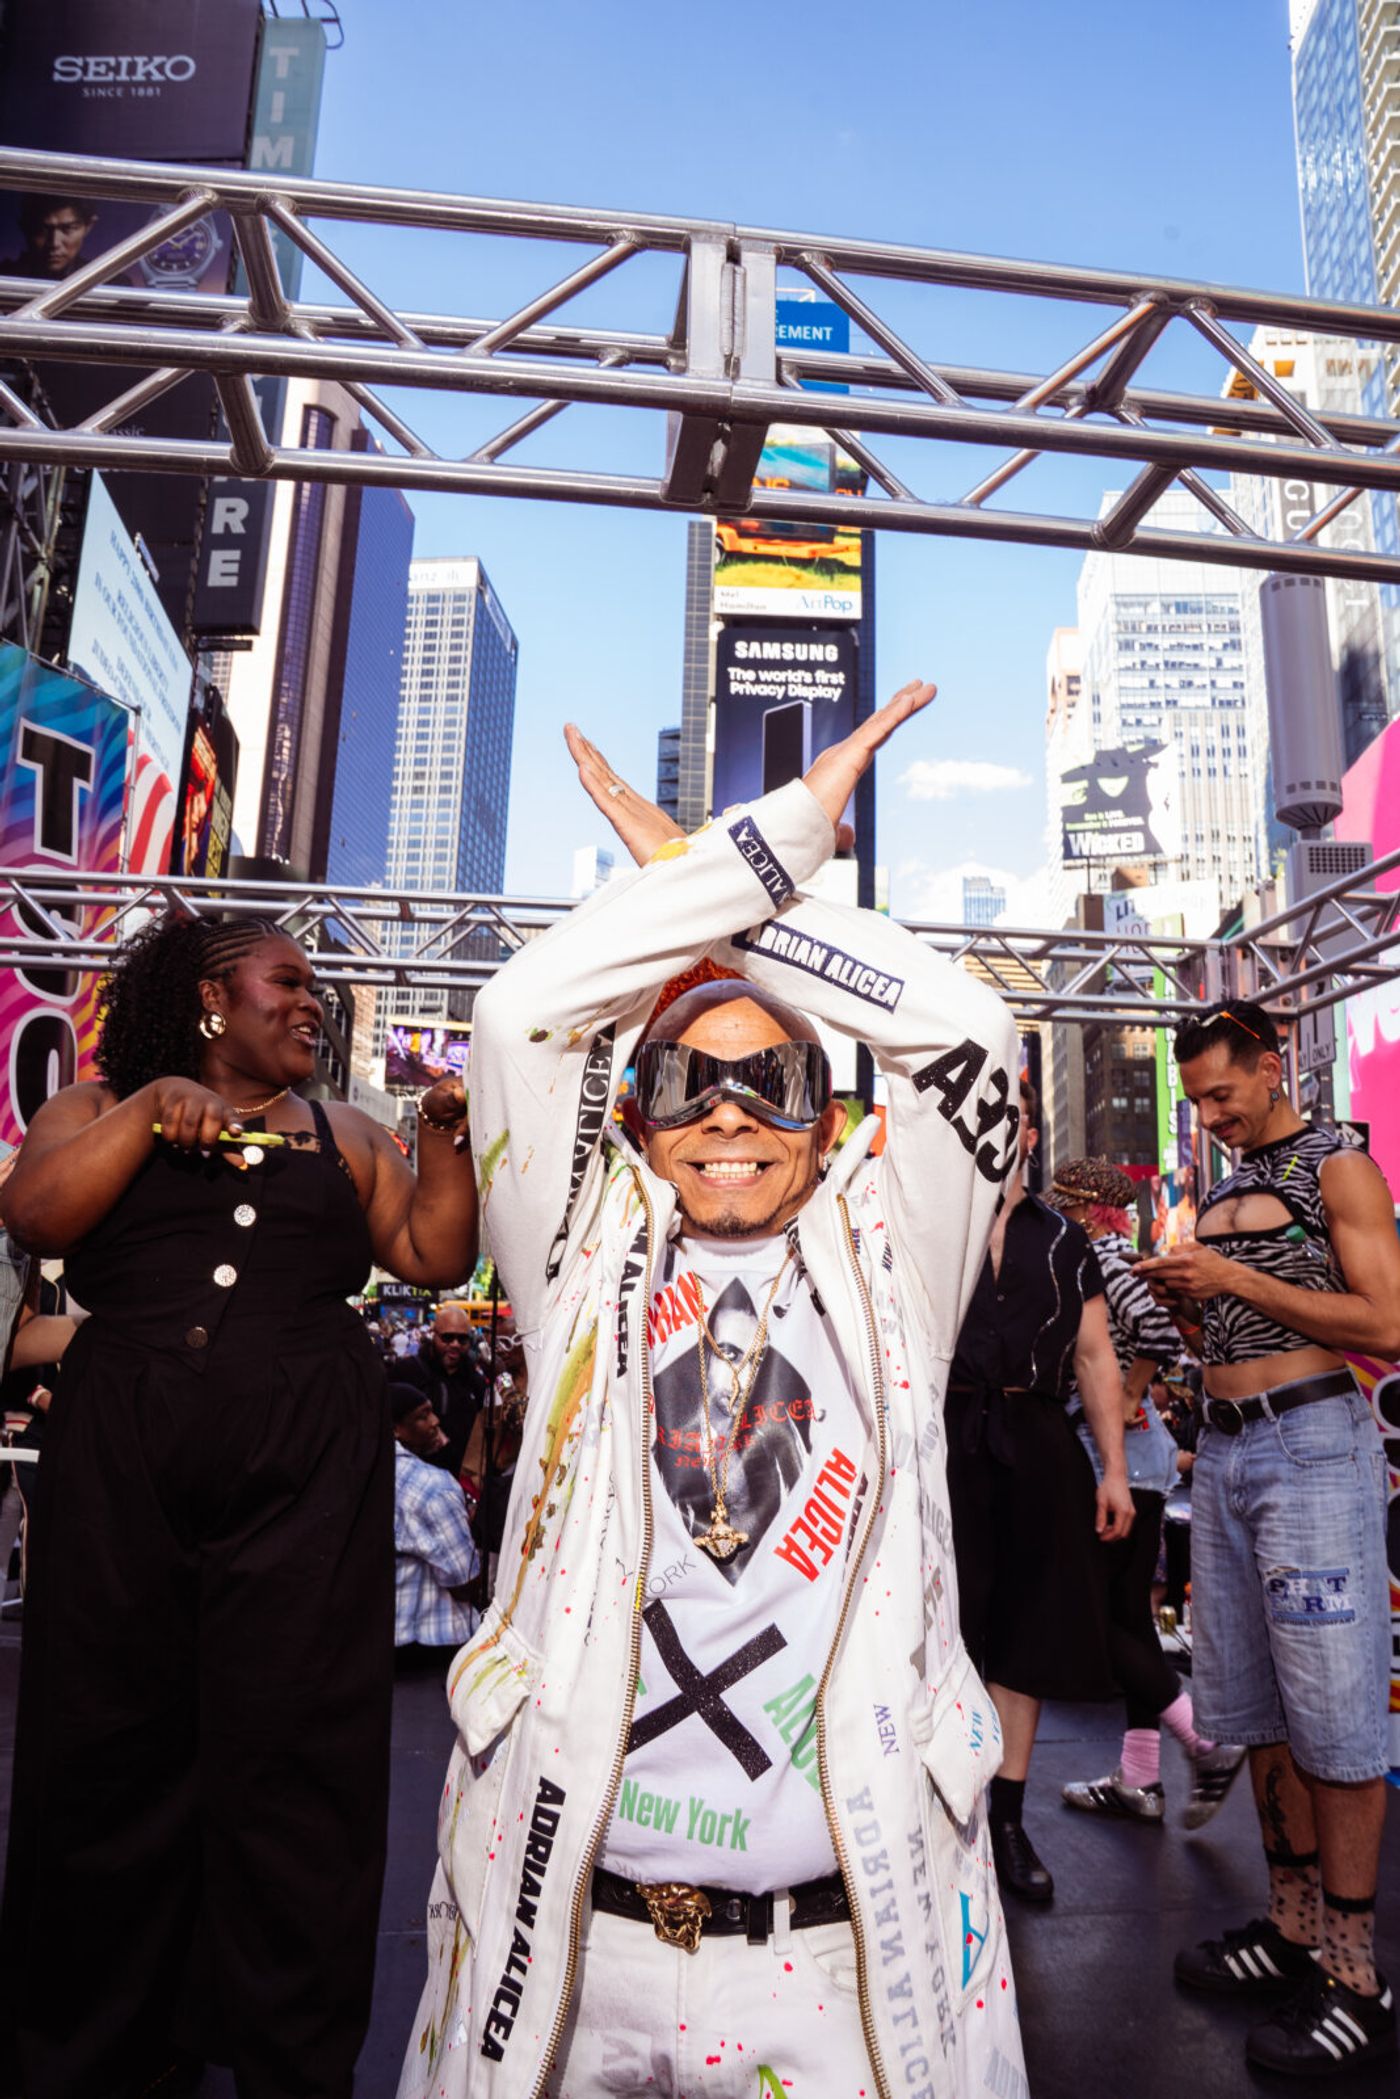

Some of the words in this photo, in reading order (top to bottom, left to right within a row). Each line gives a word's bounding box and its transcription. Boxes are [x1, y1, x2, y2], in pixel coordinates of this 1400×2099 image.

[53, 55, 196, 82] SEIKO
[83, 87, 123, 97] SINCE
[252, 47, 299, 169] TIM
[727, 667, 756, 681] The
[758, 669, 812, 684] world's
[815, 670, 845, 684] first
[734, 641, 838, 661] SAMSUNG
[730, 682, 785, 699] Privacy
[788, 684, 842, 702] Display
[824, 953, 904, 1007] ALICEA
[773, 1447, 857, 1583] ALICEA
[650, 1556, 697, 1594] ORK
[873, 1703, 900, 1758] NEW
[620, 1778, 681, 1834] New
[687, 1796, 752, 1851] York
[515, 1775, 567, 1930] ADRIAN
[480, 1927, 533, 2063] ALICEA
